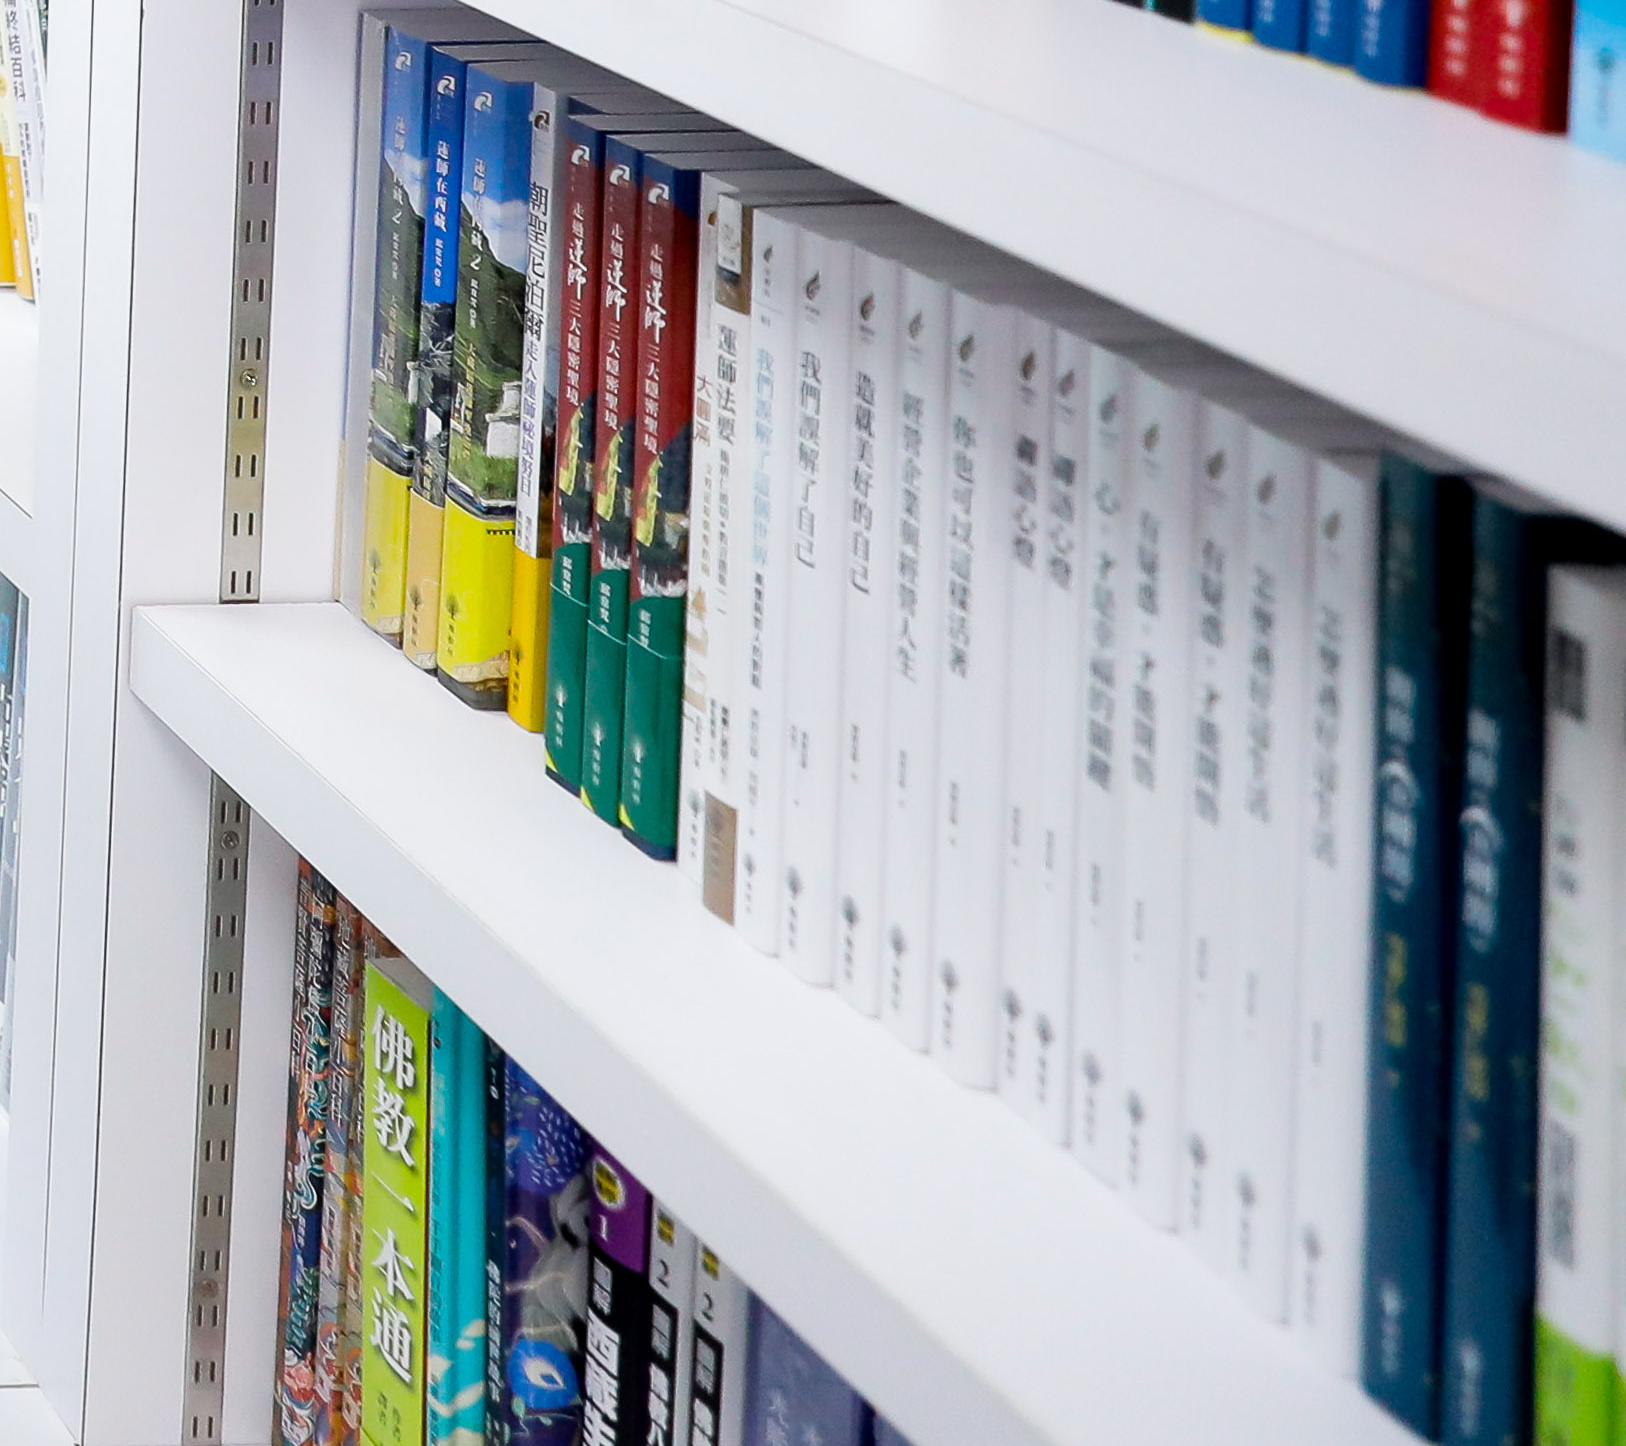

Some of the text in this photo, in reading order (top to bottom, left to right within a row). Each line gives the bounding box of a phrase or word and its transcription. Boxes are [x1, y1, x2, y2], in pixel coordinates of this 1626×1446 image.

[521, 180, 550, 343] 朝聖尼泊爾
[368, 1004, 419, 1384] 佛教一本通
[597, 1215, 609, 1242] 1
[657, 1258, 670, 1289] 2
[702, 1293, 714, 1323] 2
